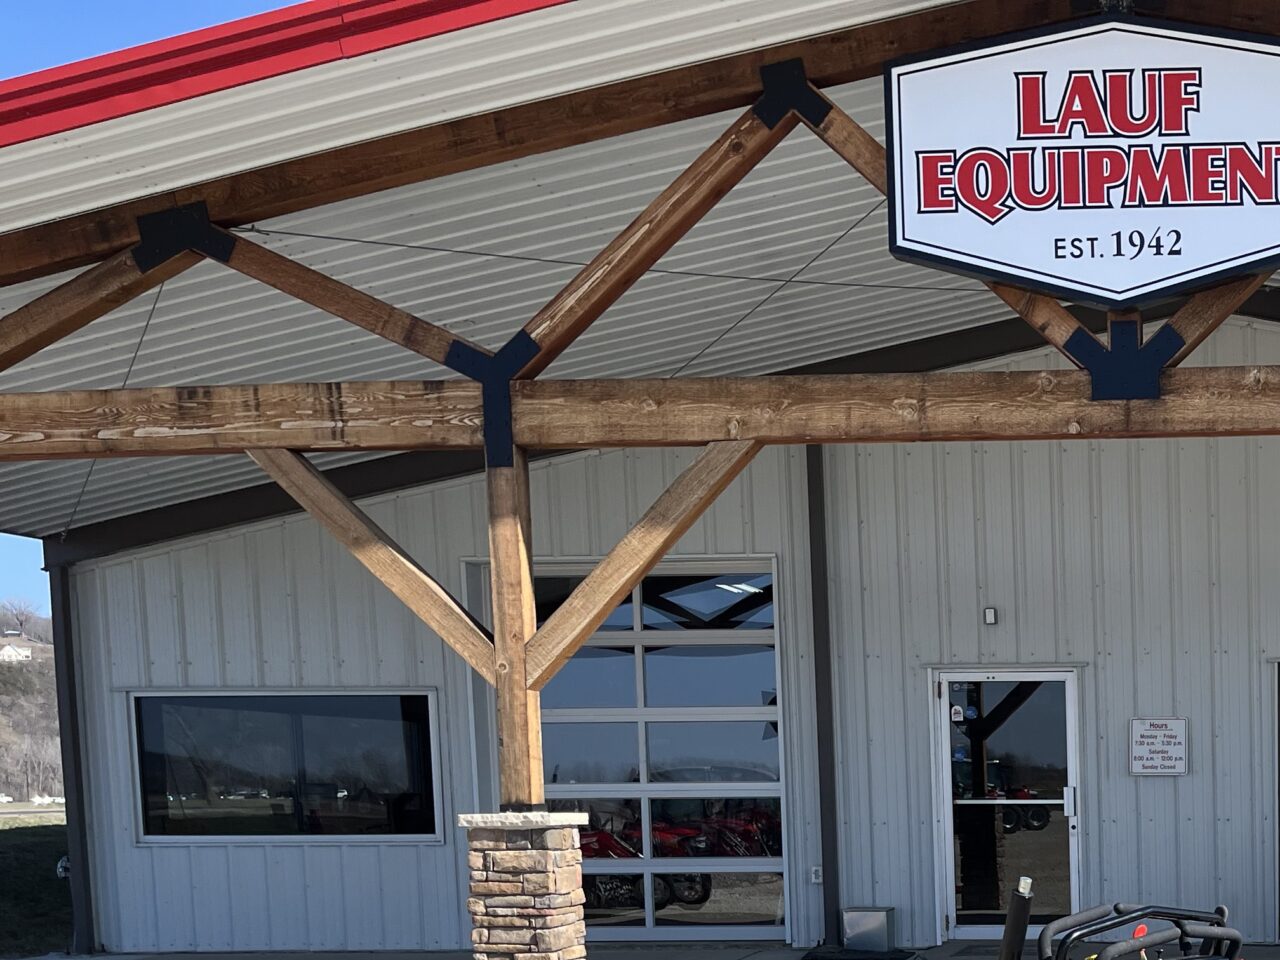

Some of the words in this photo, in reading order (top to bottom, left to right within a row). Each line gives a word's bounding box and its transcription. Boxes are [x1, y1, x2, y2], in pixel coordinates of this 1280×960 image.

[1014, 67, 1201, 139] LAUF
[1054, 237, 1105, 259] EST.
[1110, 226, 1183, 261] 1942
